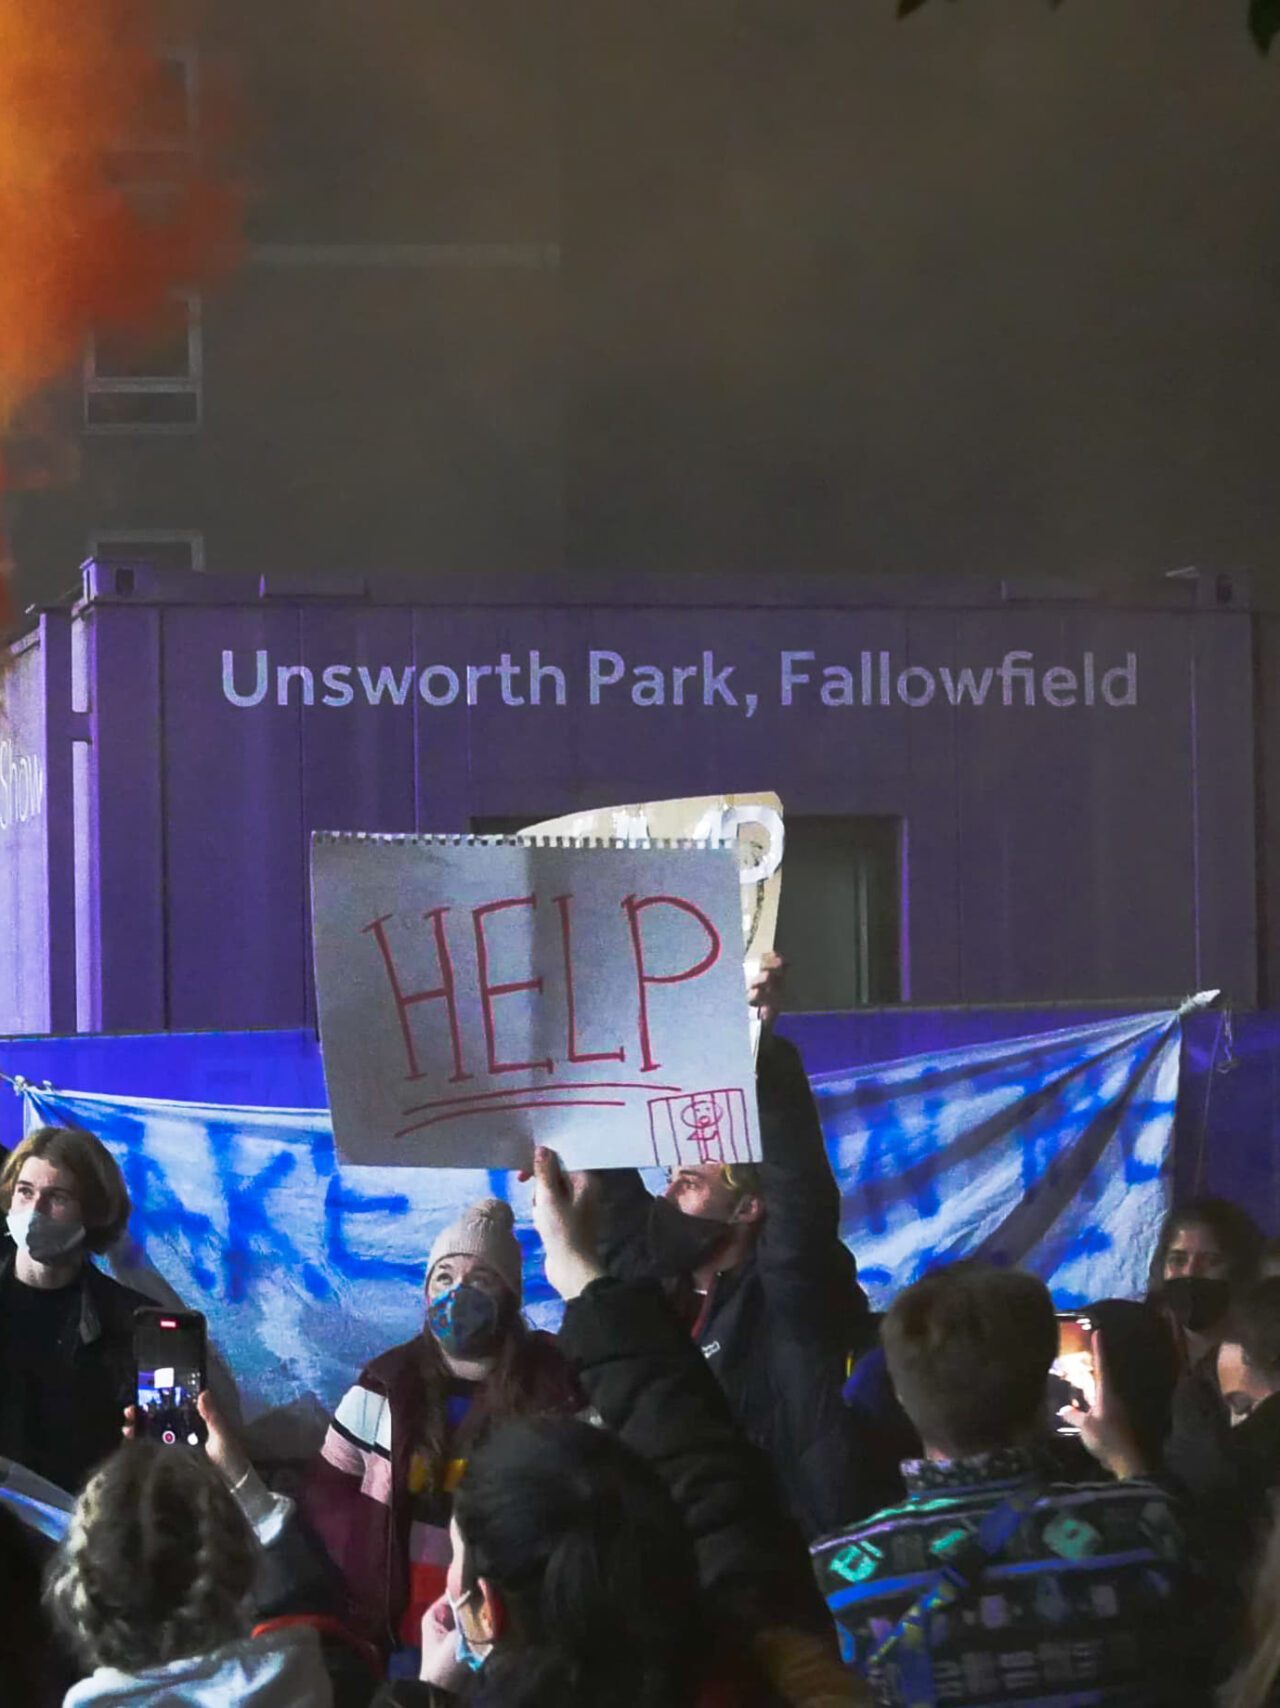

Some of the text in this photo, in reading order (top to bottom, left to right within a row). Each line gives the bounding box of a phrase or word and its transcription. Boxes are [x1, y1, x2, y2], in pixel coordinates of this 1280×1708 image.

[222, 650, 1137, 718] Unsworth Park, Fallowfield
[361, 893, 723, 1083] HELP
